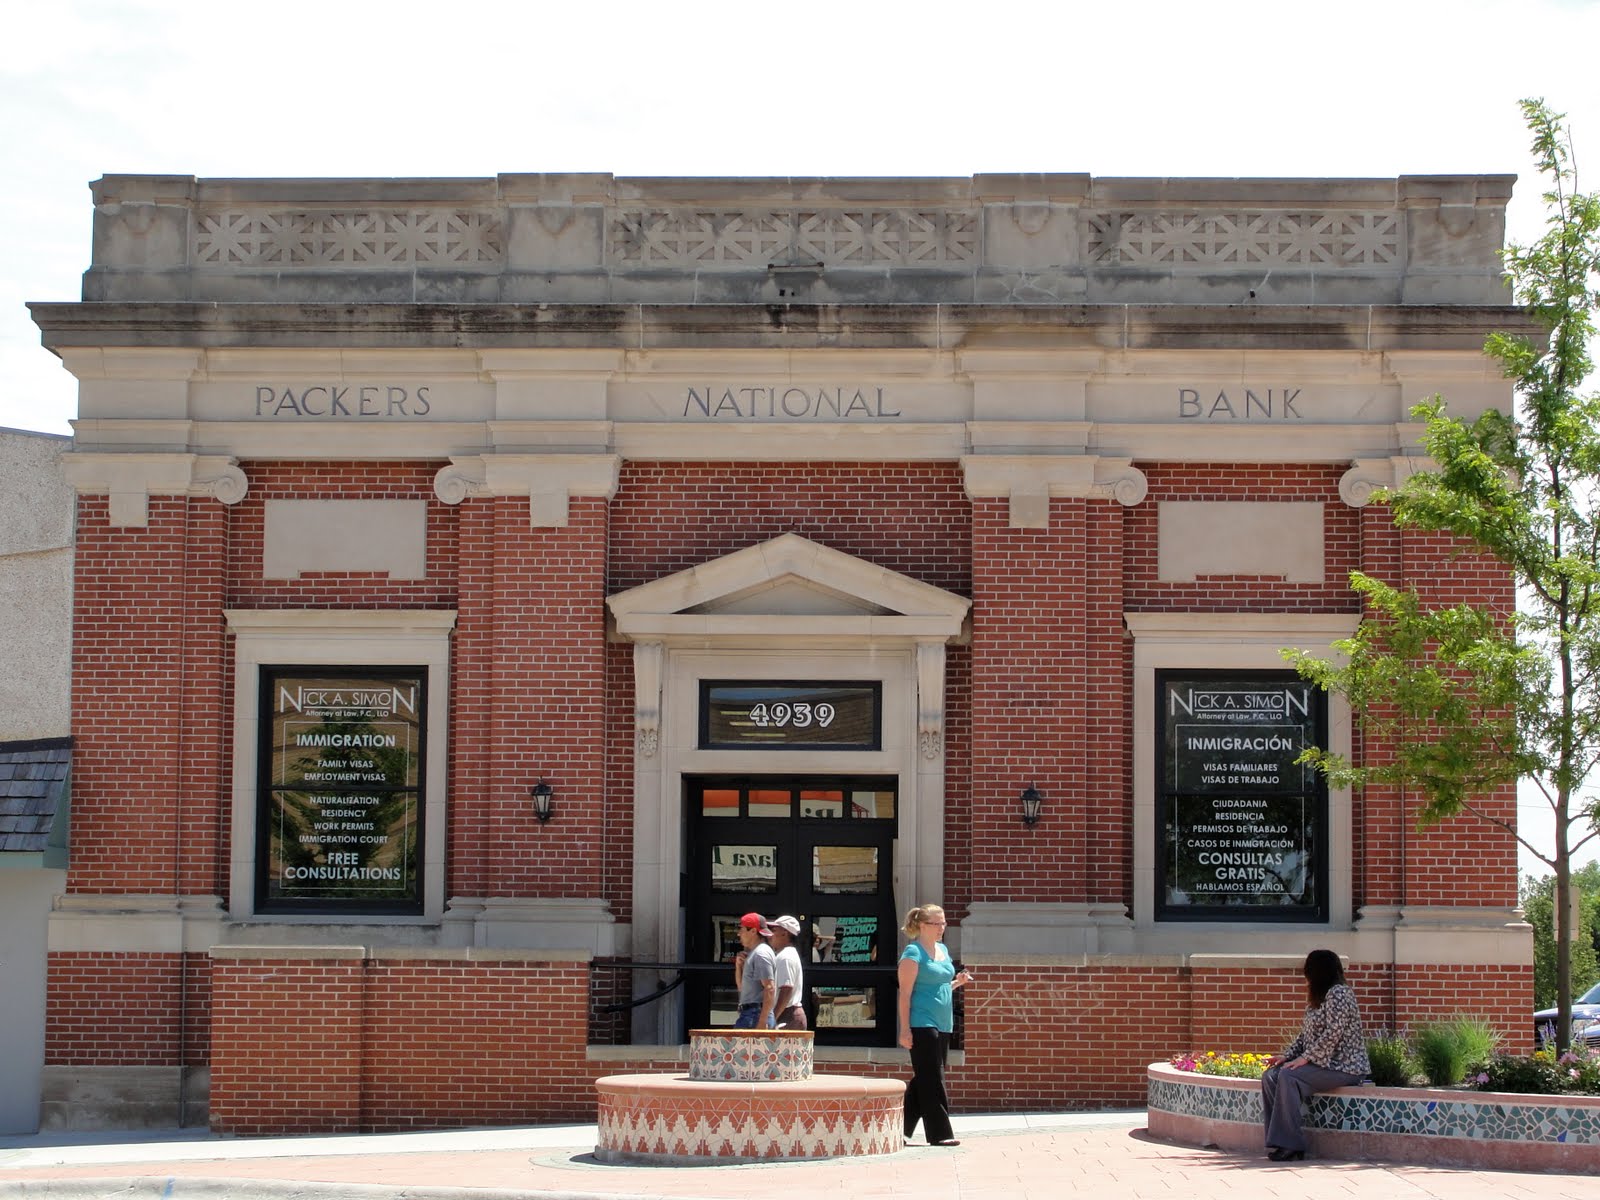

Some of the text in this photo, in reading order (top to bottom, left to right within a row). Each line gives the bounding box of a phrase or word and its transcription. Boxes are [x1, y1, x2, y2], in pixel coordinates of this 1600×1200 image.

[254, 386, 1304, 419] PACKERS NATIONAL BANK
[280, 686, 414, 713] NICK A. SIMON
[1171, 688, 1308, 716] NICK A. SIMON
[305, 709, 333, 718] Attorney
[377, 710, 389, 718] LLO
[749, 702, 835, 728] 4939
[1197, 713, 1226, 721] Attorney
[296, 734, 396, 747] IMMIGRATION
[1188, 734, 1292, 750] INMIGRACIÓN
[317, 760, 374, 769] FAMILY VISAS
[1203, 763, 1278, 772] VISAS FAMILIARES
[304, 773, 386, 781] EMPLOYMENT VISAS
[1201, 776, 1280, 784] VISAS DE TRABAJO
[309, 796, 380, 805] NATURALIZATION
[1212, 800, 1268, 808] CIUDADANIA
[321, 809, 367, 818] RESIDENCY
[1215, 812, 1265, 821] RESIDENCIA
[314, 822, 375, 830] WORK PERMITS
[1192, 825, 1288, 834] PERMISOS DE TRABAJO
[299, 835, 388, 844] IMMIGRATION COURT
[1187, 838, 1294, 848] CASOS DE INMIGRACIÓN
[327, 852, 359, 865] FREE
[1198, 852, 1283, 866] CONSULTAS
[285, 867, 401, 880] CONSULTATIONS
[1215, 867, 1266, 880] GRATIS
[1196, 882, 1285, 892] HABLAMOS ESPAÑOL
